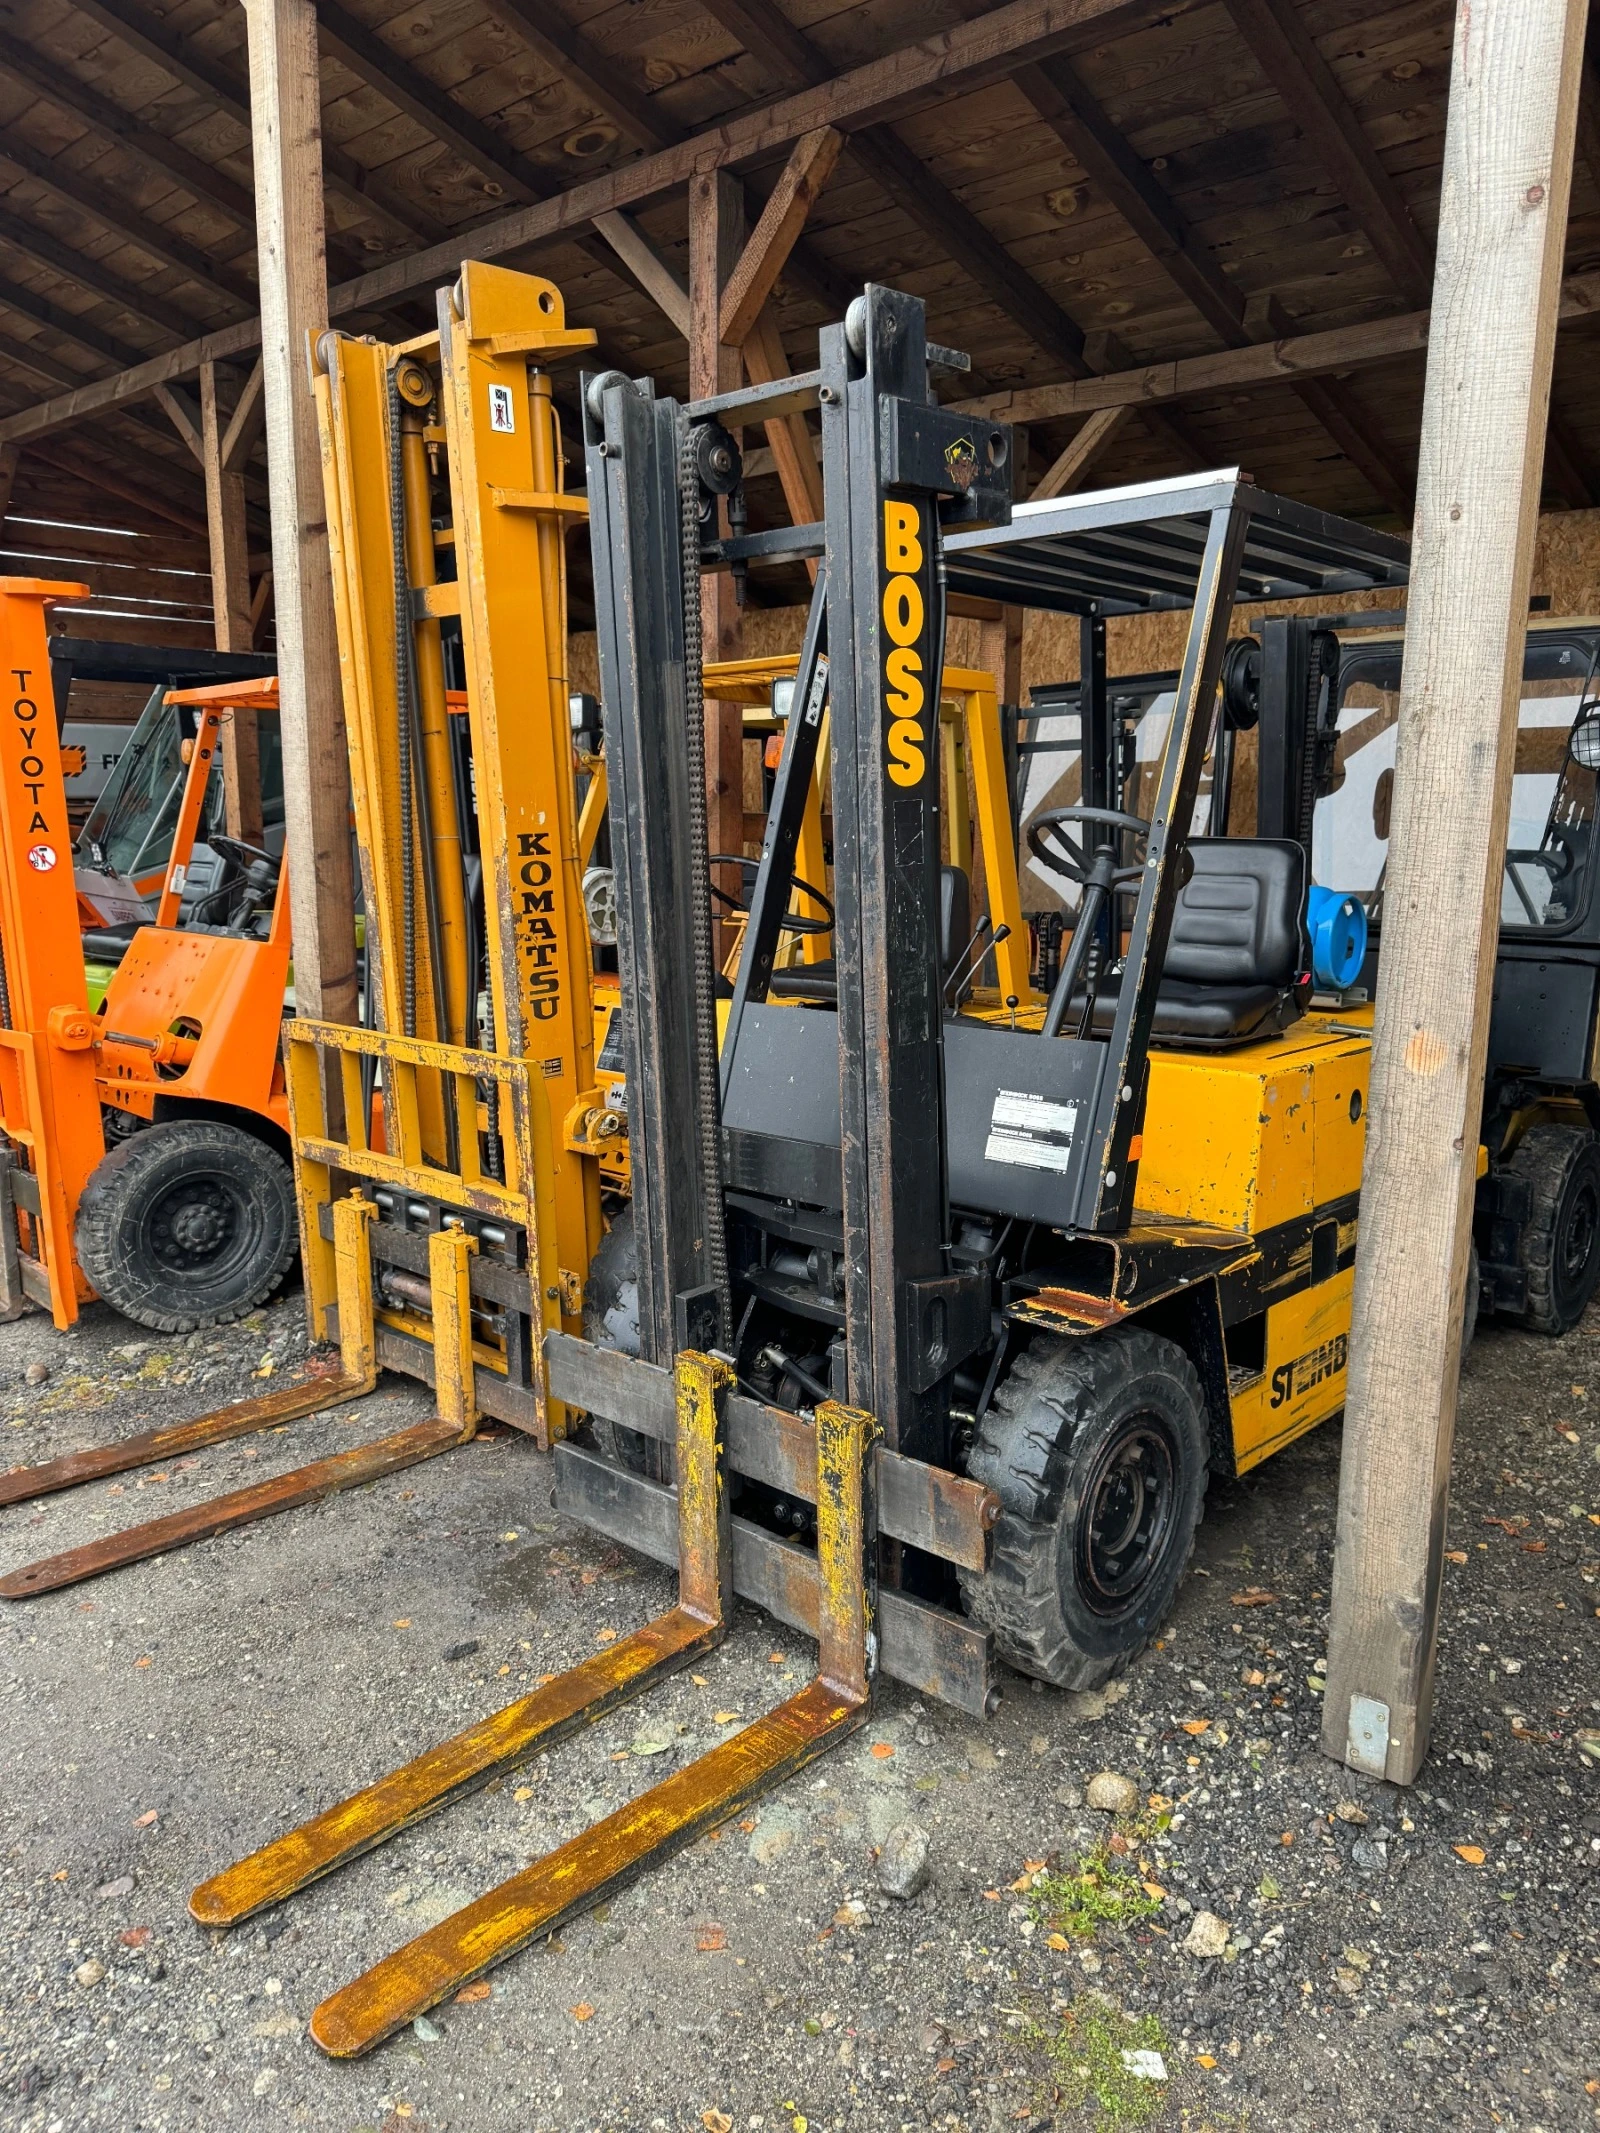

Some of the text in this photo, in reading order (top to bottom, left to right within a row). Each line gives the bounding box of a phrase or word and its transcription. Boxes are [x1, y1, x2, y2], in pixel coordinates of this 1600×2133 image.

[883, 500, 925, 787] BOSS
[12, 670, 49, 833] TOYOTA
[517, 833, 560, 1020] KOMATSU
